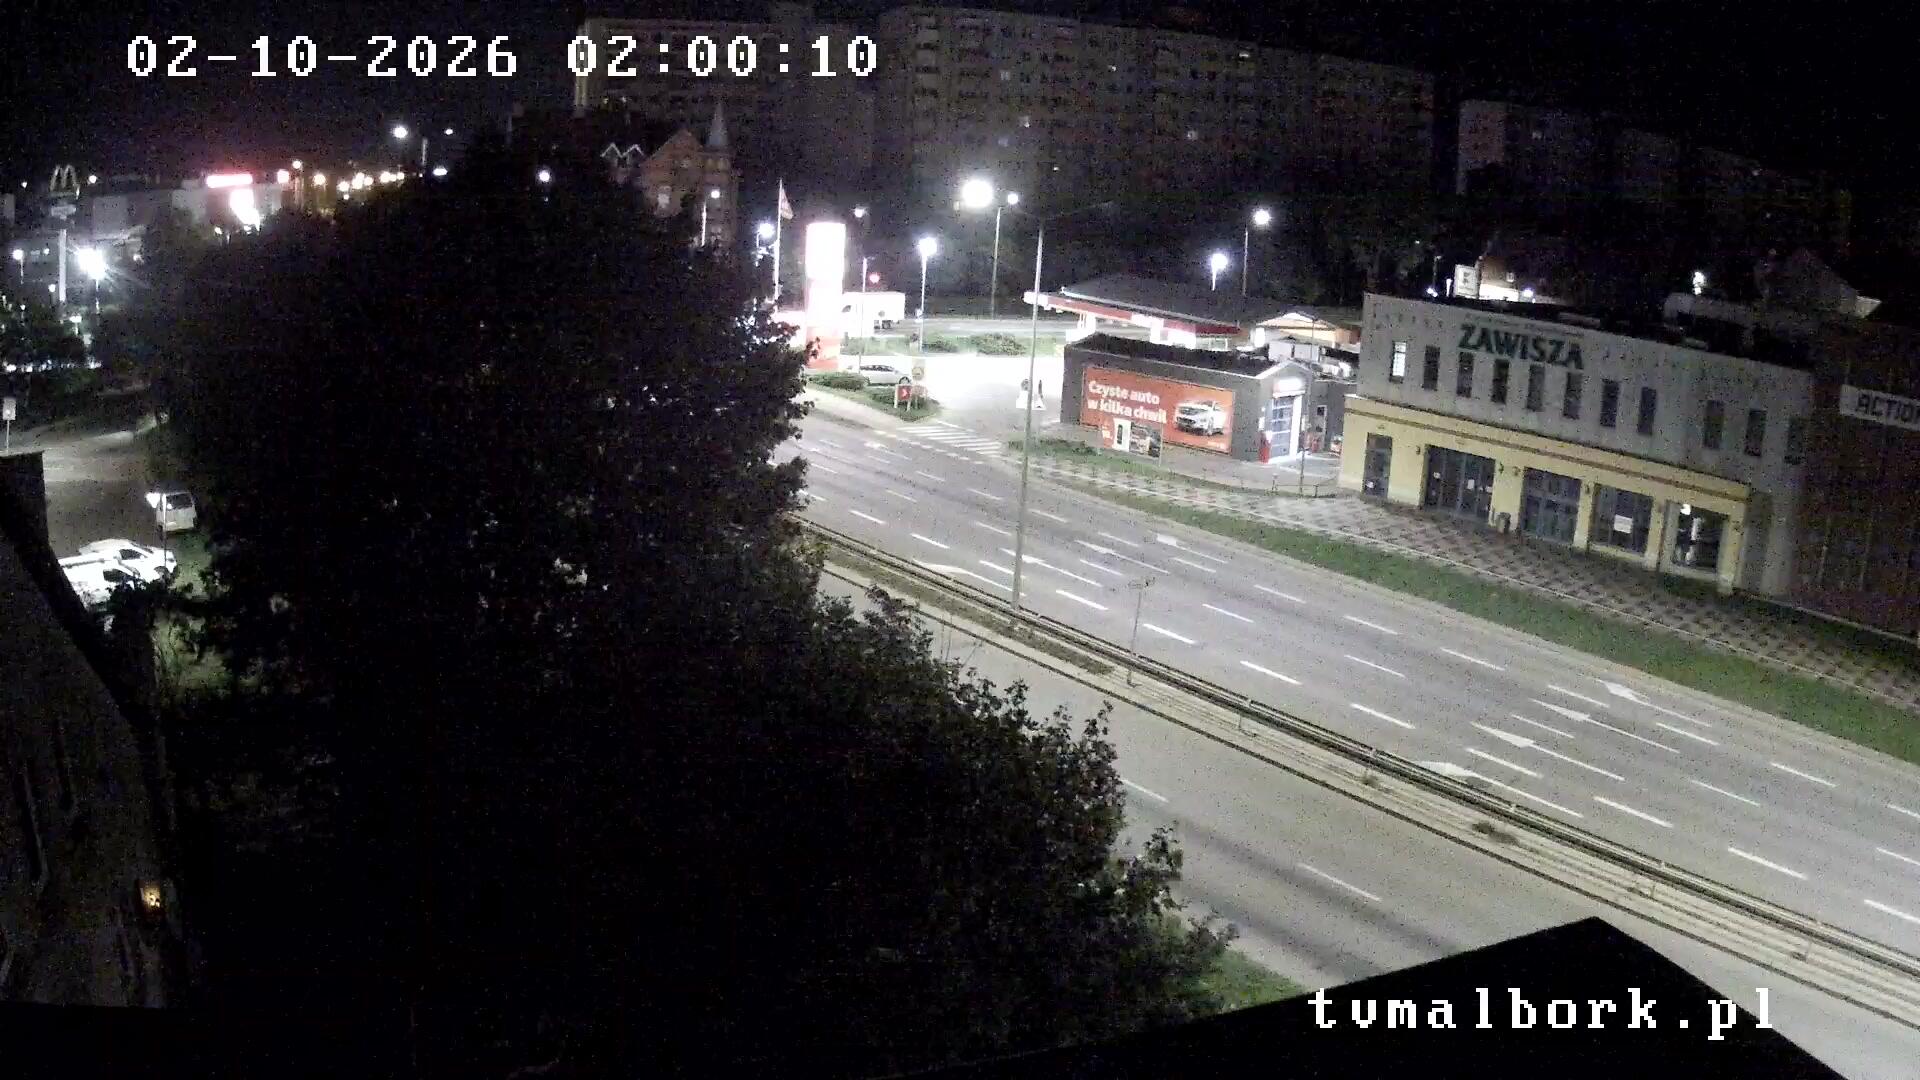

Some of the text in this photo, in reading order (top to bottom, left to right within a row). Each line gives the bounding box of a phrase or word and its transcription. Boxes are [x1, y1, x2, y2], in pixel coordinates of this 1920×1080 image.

[1458, 323, 1585, 370] ZAWISZA
[1088, 380, 1160, 405] Czyste auto
[1087, 398, 1167, 424] w kilka chwil
